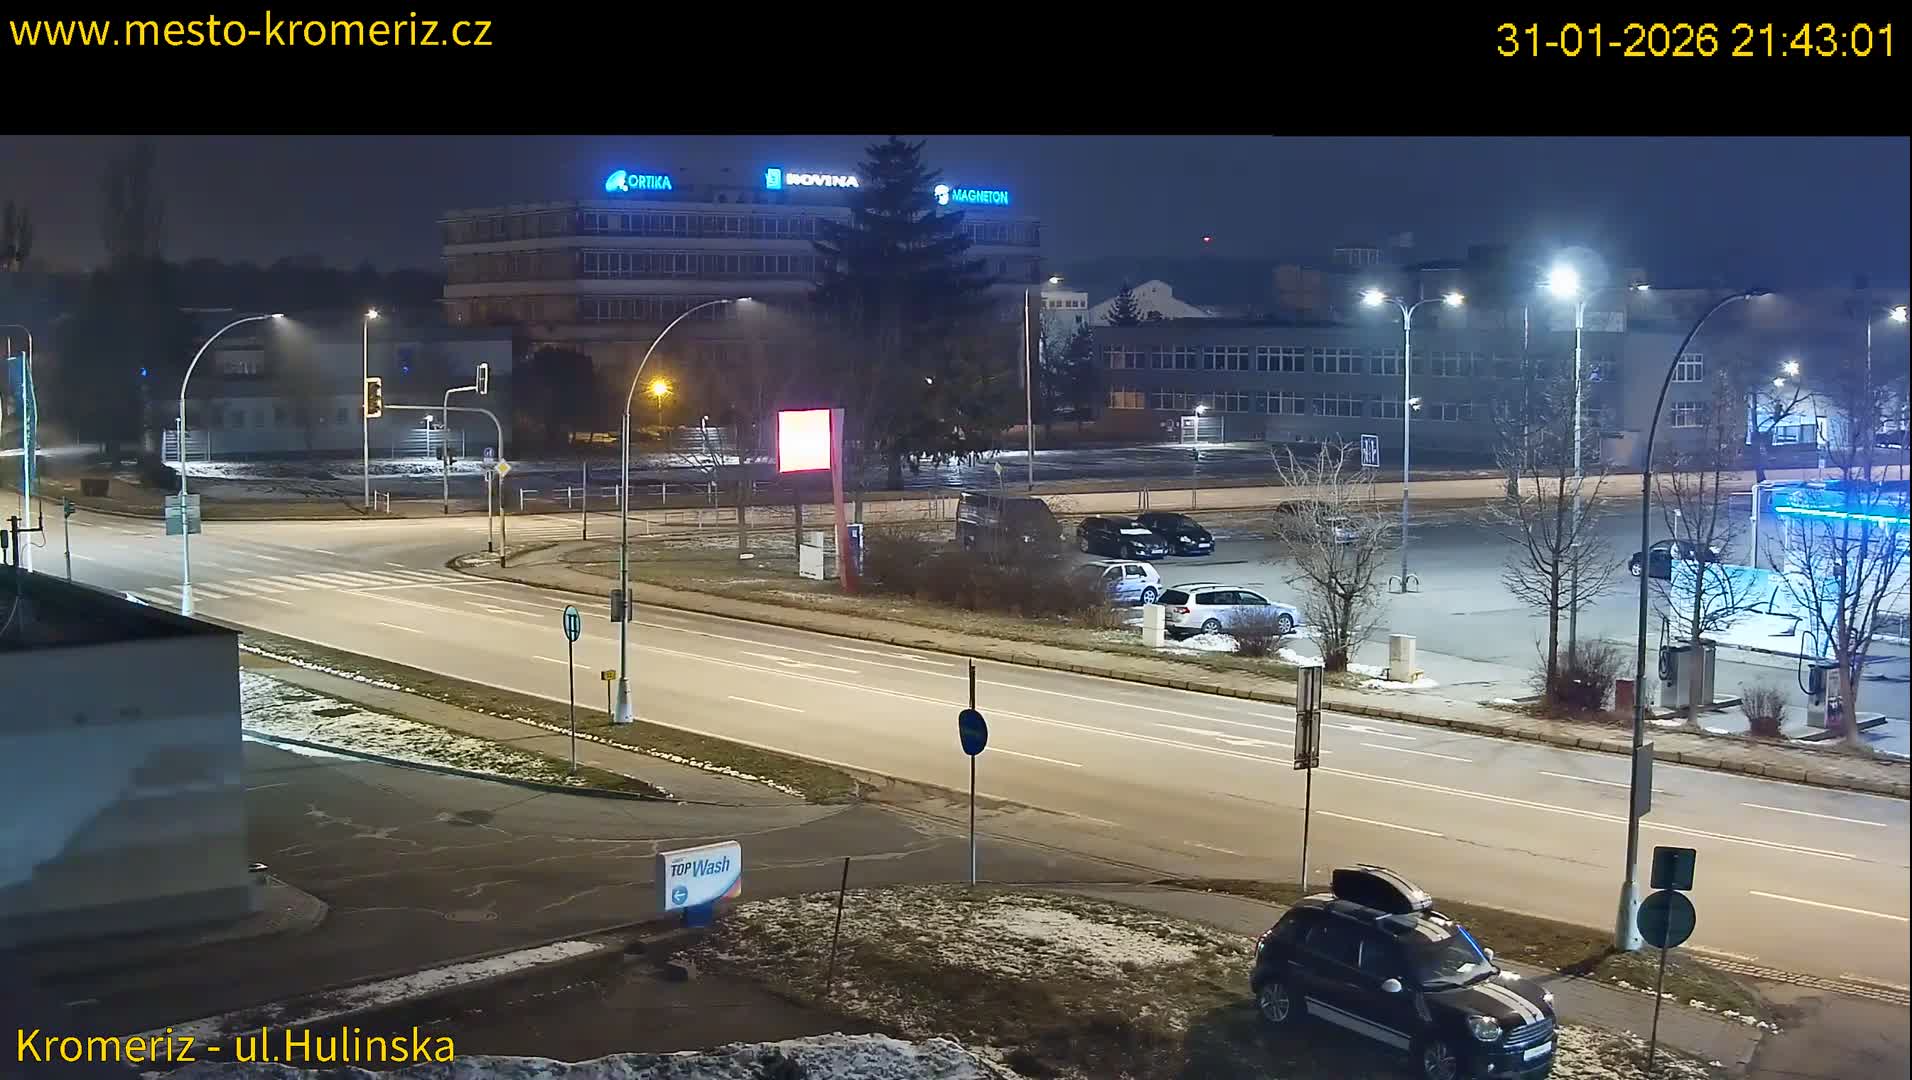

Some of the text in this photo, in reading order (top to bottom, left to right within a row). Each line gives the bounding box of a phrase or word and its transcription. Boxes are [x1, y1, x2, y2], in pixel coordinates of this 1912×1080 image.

[628, 174, 672, 190] ORTIKA
[786, 173, 859, 188] ROVINA
[952, 188, 1009, 205] MAGNETON
